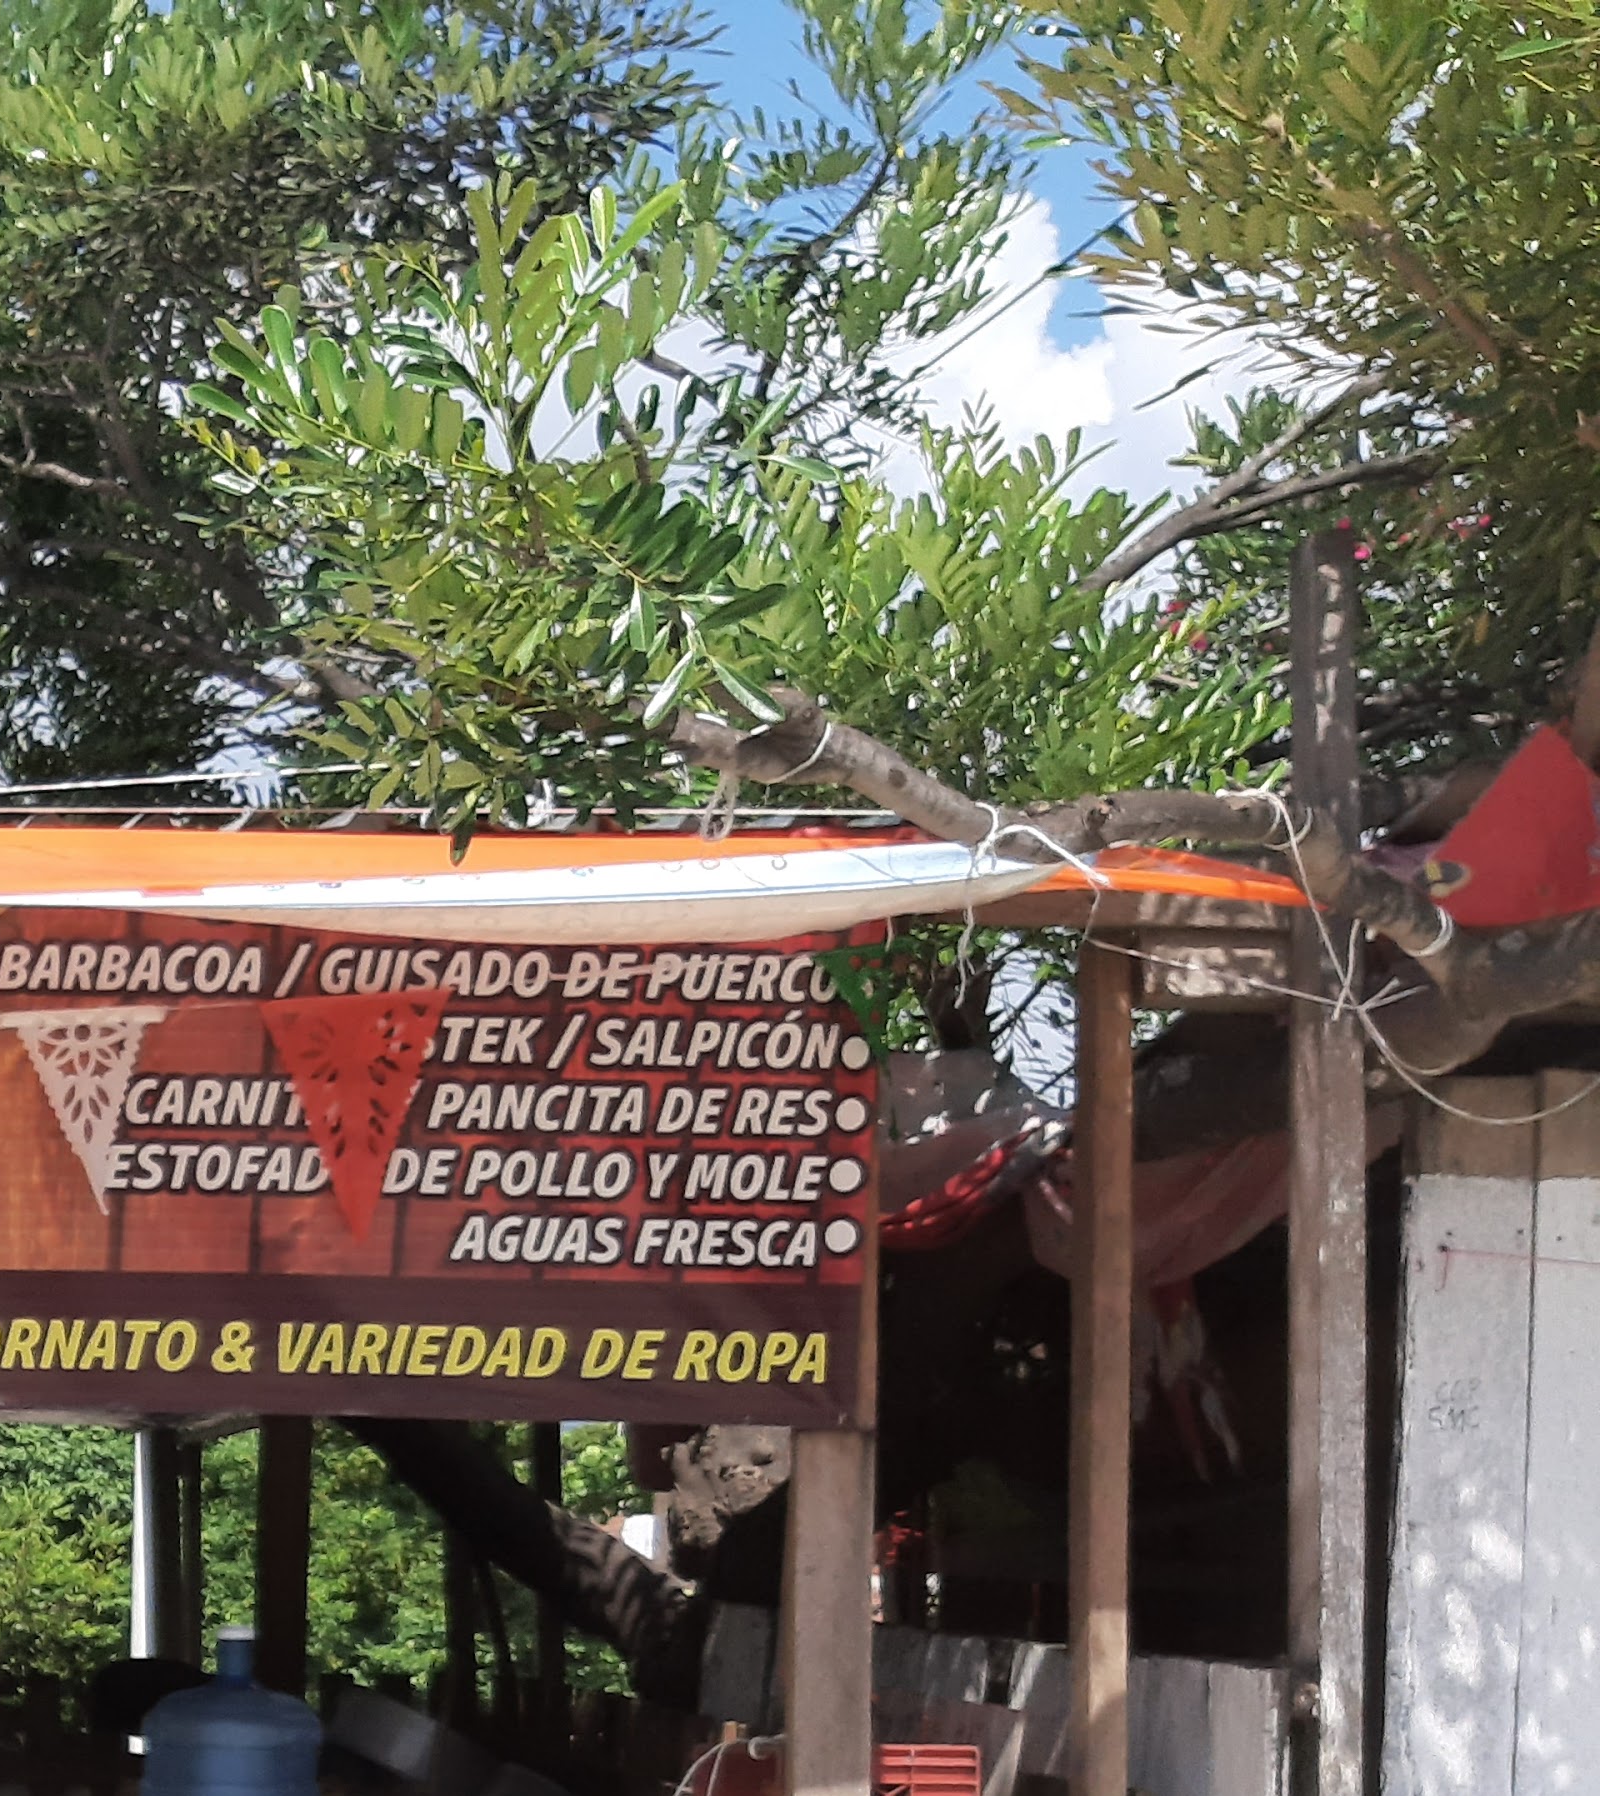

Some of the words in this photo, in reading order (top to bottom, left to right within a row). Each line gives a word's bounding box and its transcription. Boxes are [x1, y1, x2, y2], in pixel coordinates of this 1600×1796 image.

[275, 943, 312, 998] /
[318, 948, 550, 998] GUISADO
[562, 952, 634, 1000] DE
[546, 1014, 586, 1069] /
[590, 1010, 840, 1071] SALPICÓN
[125, 1078, 330, 1126] CARNIT
[427, 1083, 646, 1132] PANCITA
[655, 1087, 728, 1134] DE
[730, 1087, 834, 1136] RES
[104, 1143, 335, 1193] ESTOFAD
[381, 1147, 458, 1194] DE
[464, 1149, 638, 1198] POLLO
[646, 1152, 676, 1198] Y
[682, 1154, 824, 1201] MOLE
[450, 1215, 622, 1264] AGUAS
[633, 1217, 820, 1268] FRESCA
[210, 1320, 255, 1374] &
[275, 1322, 566, 1378] VARIEDAD
[580, 1328, 666, 1380] DE
[673, 1331, 830, 1385] ROPA
